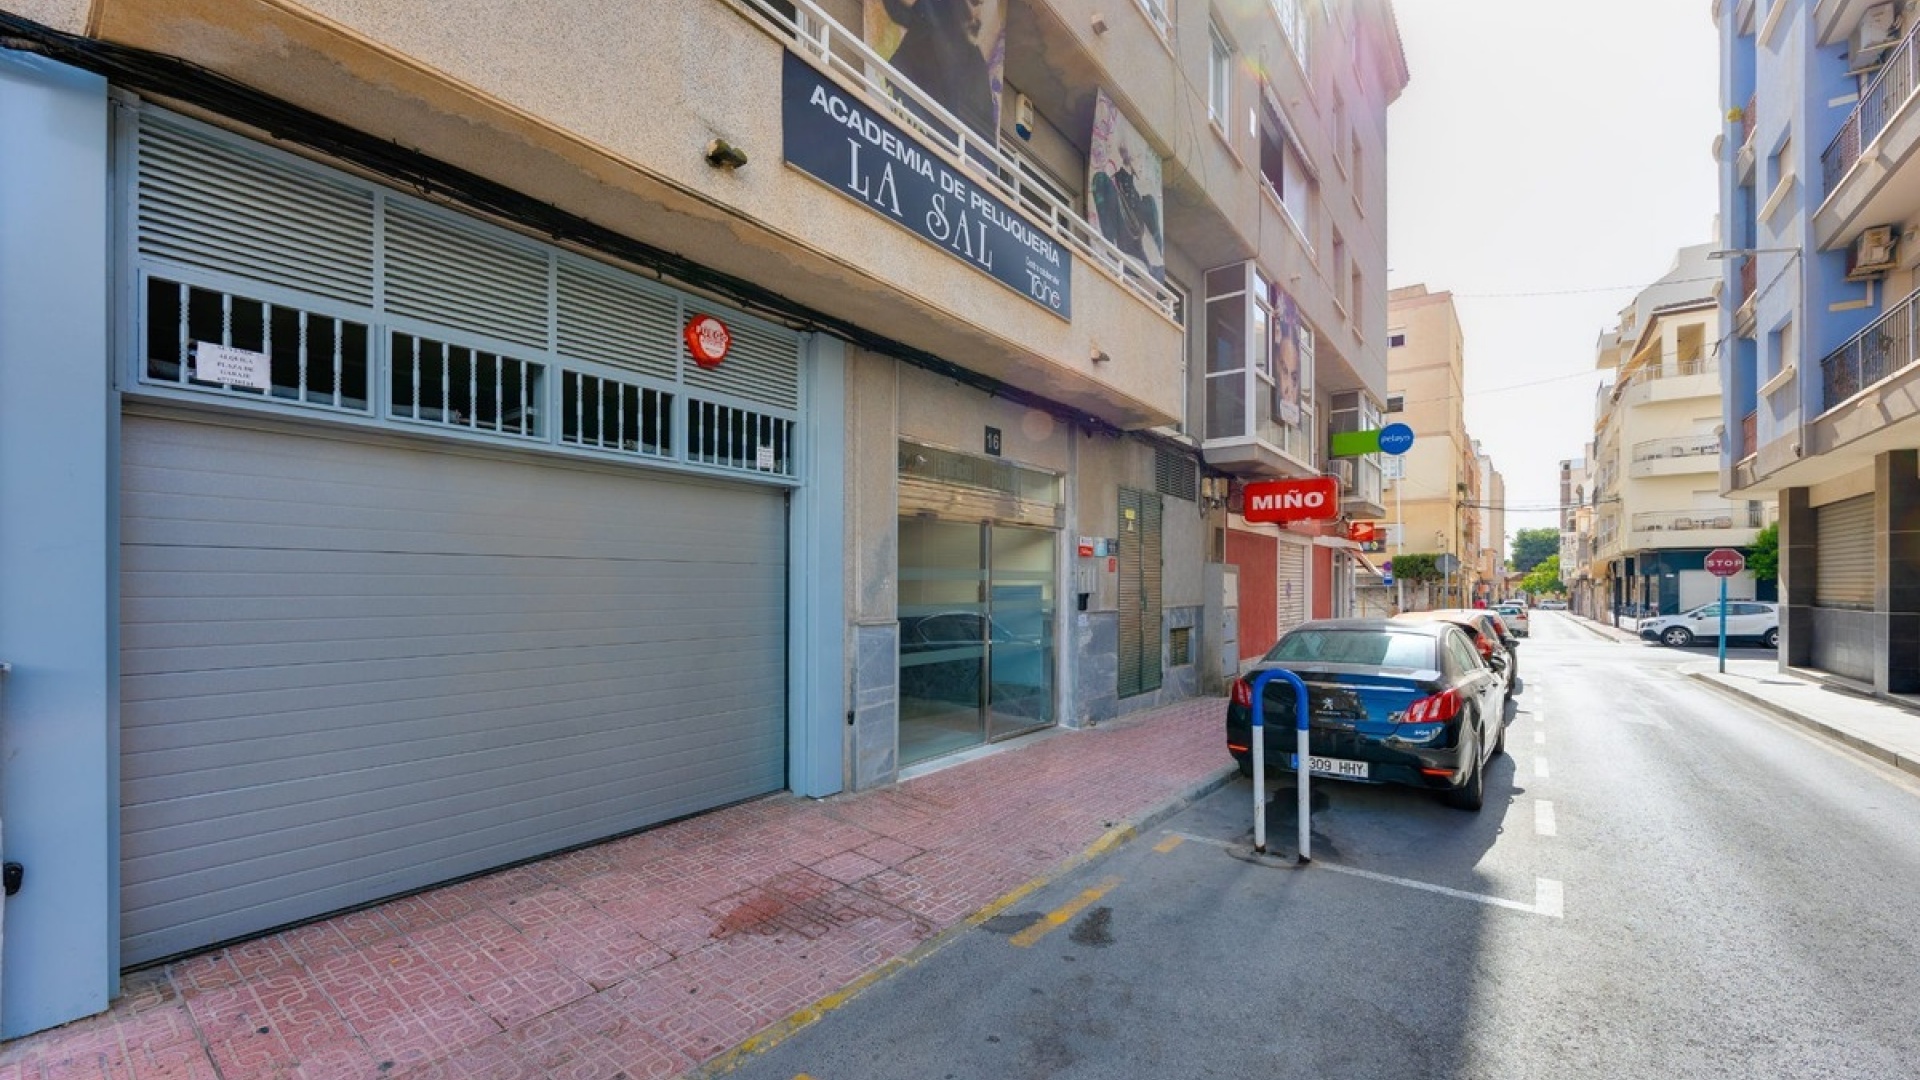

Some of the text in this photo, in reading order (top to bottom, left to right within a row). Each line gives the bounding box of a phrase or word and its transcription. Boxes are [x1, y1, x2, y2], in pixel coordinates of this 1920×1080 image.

[810, 84, 935, 182] ACADEMIA
[940, 170, 966, 202] DE
[971, 191, 1060, 268] PELUQUERÍA
[848, 137, 993, 271] LA SAL
[987, 432, 999, 450] 16
[1252, 489, 1324, 511] MIÑO
[1708, 559, 1742, 567] STOP
[1308, 757, 1364, 775] 309 HHY
